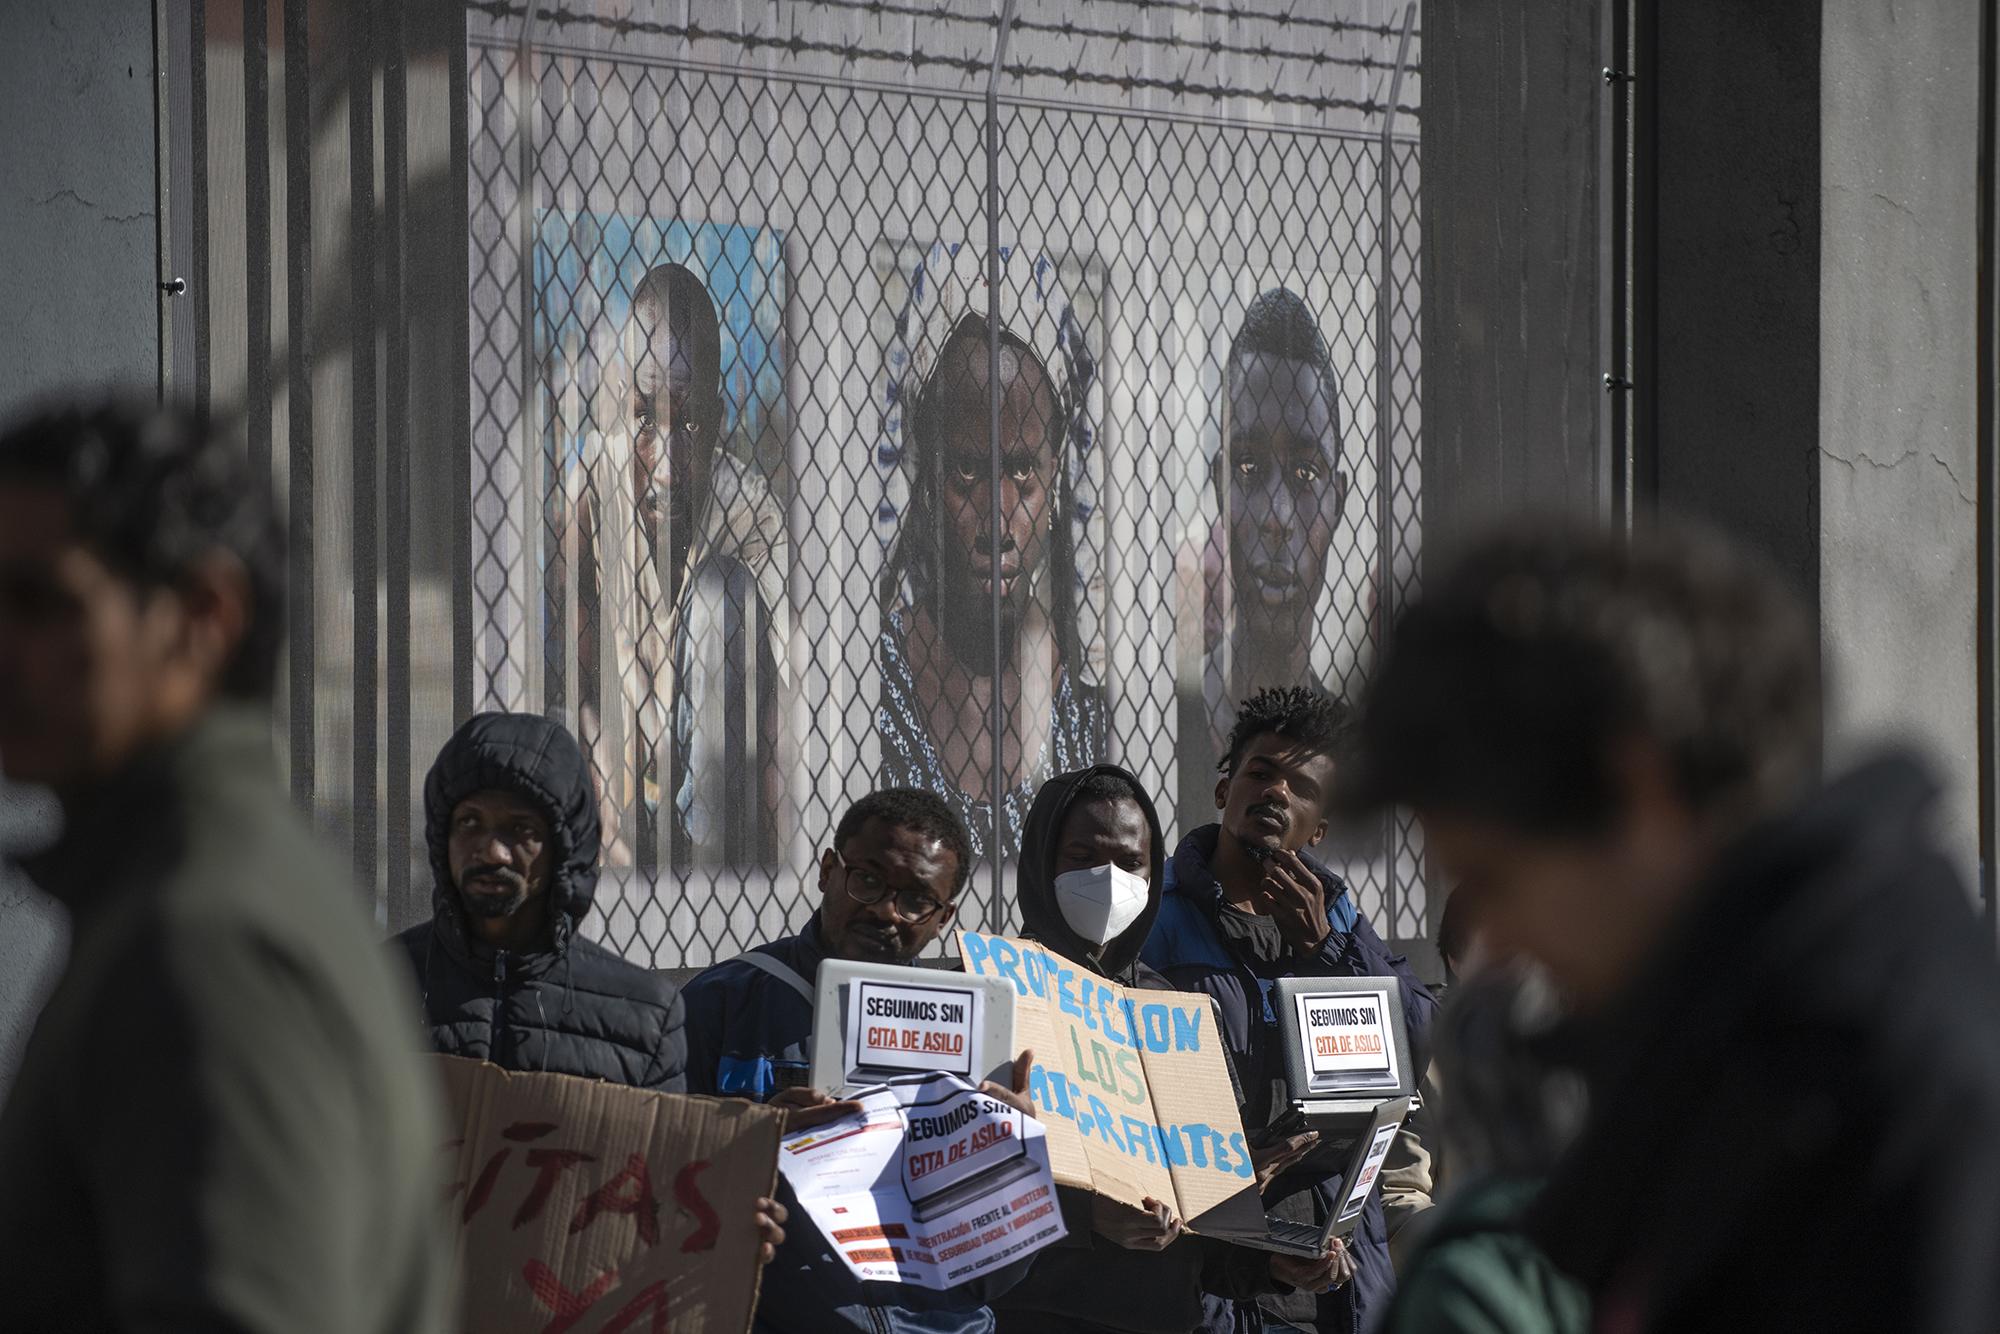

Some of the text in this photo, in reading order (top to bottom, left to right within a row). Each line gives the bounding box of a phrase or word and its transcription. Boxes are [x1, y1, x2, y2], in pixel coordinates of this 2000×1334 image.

[867, 997, 964, 1023] SEGUIMOS SIN
[1310, 1007, 1377, 1027] SEGUIMOS SIN
[868, 1026, 963, 1053] CITA DE ASILO
[1316, 1034, 1381, 1054] CITA DE ASILO
[1070, 1024, 1146, 1105] LOS
[983, 1101, 1012, 1114] SIN
[1030, 1064, 1253, 1178] MIGRANTES
[909, 1150, 945, 1177] CITA
[948, 1138, 968, 1162] DE
[970, 1121, 1012, 1152] ASILO
[445, 1122, 721, 1254] ITAS
[971, 1208, 1002, 1231] FRENTE
[1001, 1204, 1012, 1219] AL
[981, 1223, 1008, 1244] SOCIAL
